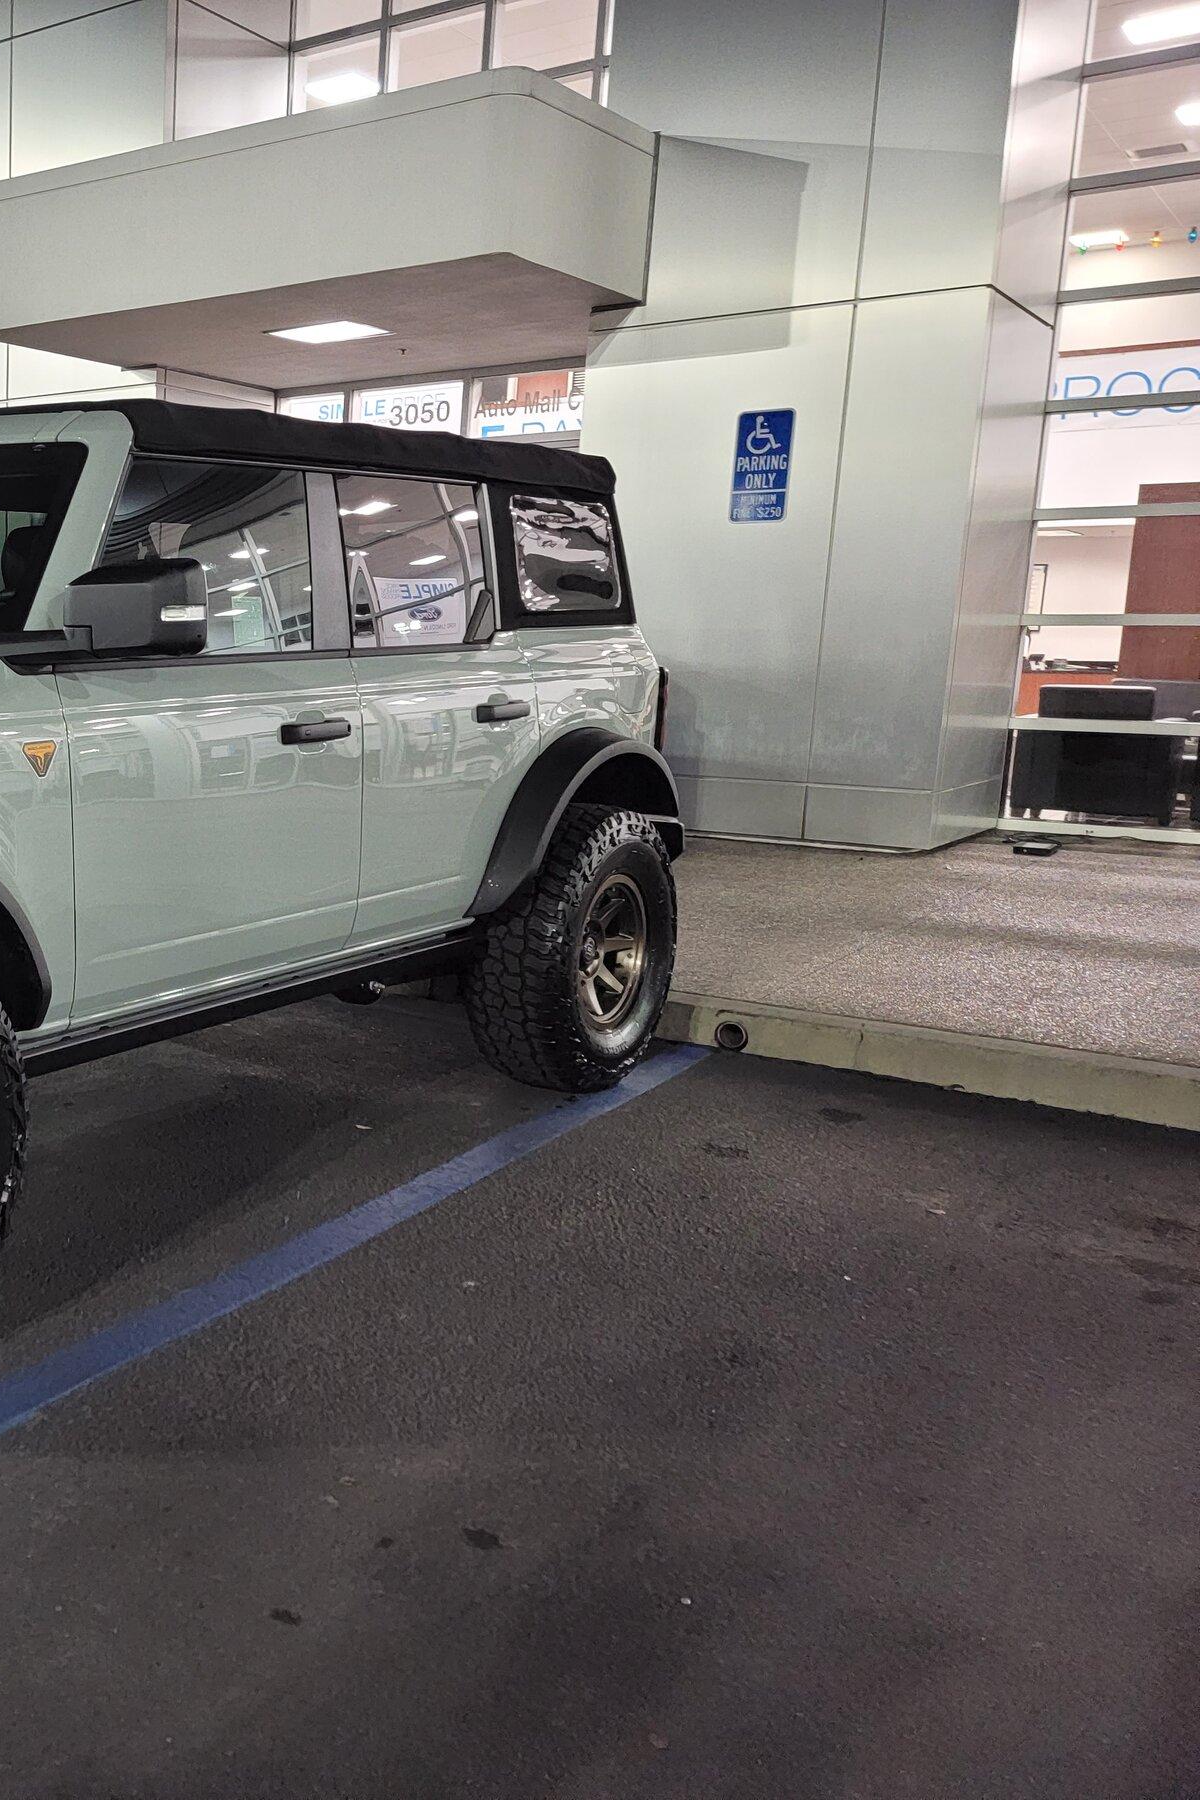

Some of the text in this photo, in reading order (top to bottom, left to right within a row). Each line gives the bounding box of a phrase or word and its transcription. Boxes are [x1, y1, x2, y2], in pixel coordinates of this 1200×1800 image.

[474, 395, 517, 419] Auto
[524, 388, 561, 414] Mall
[389, 400, 450, 427] 3050
[736, 454, 788, 472] PARKING
[745, 473, 777, 489] ONLY
[756, 507, 782, 518] $250
